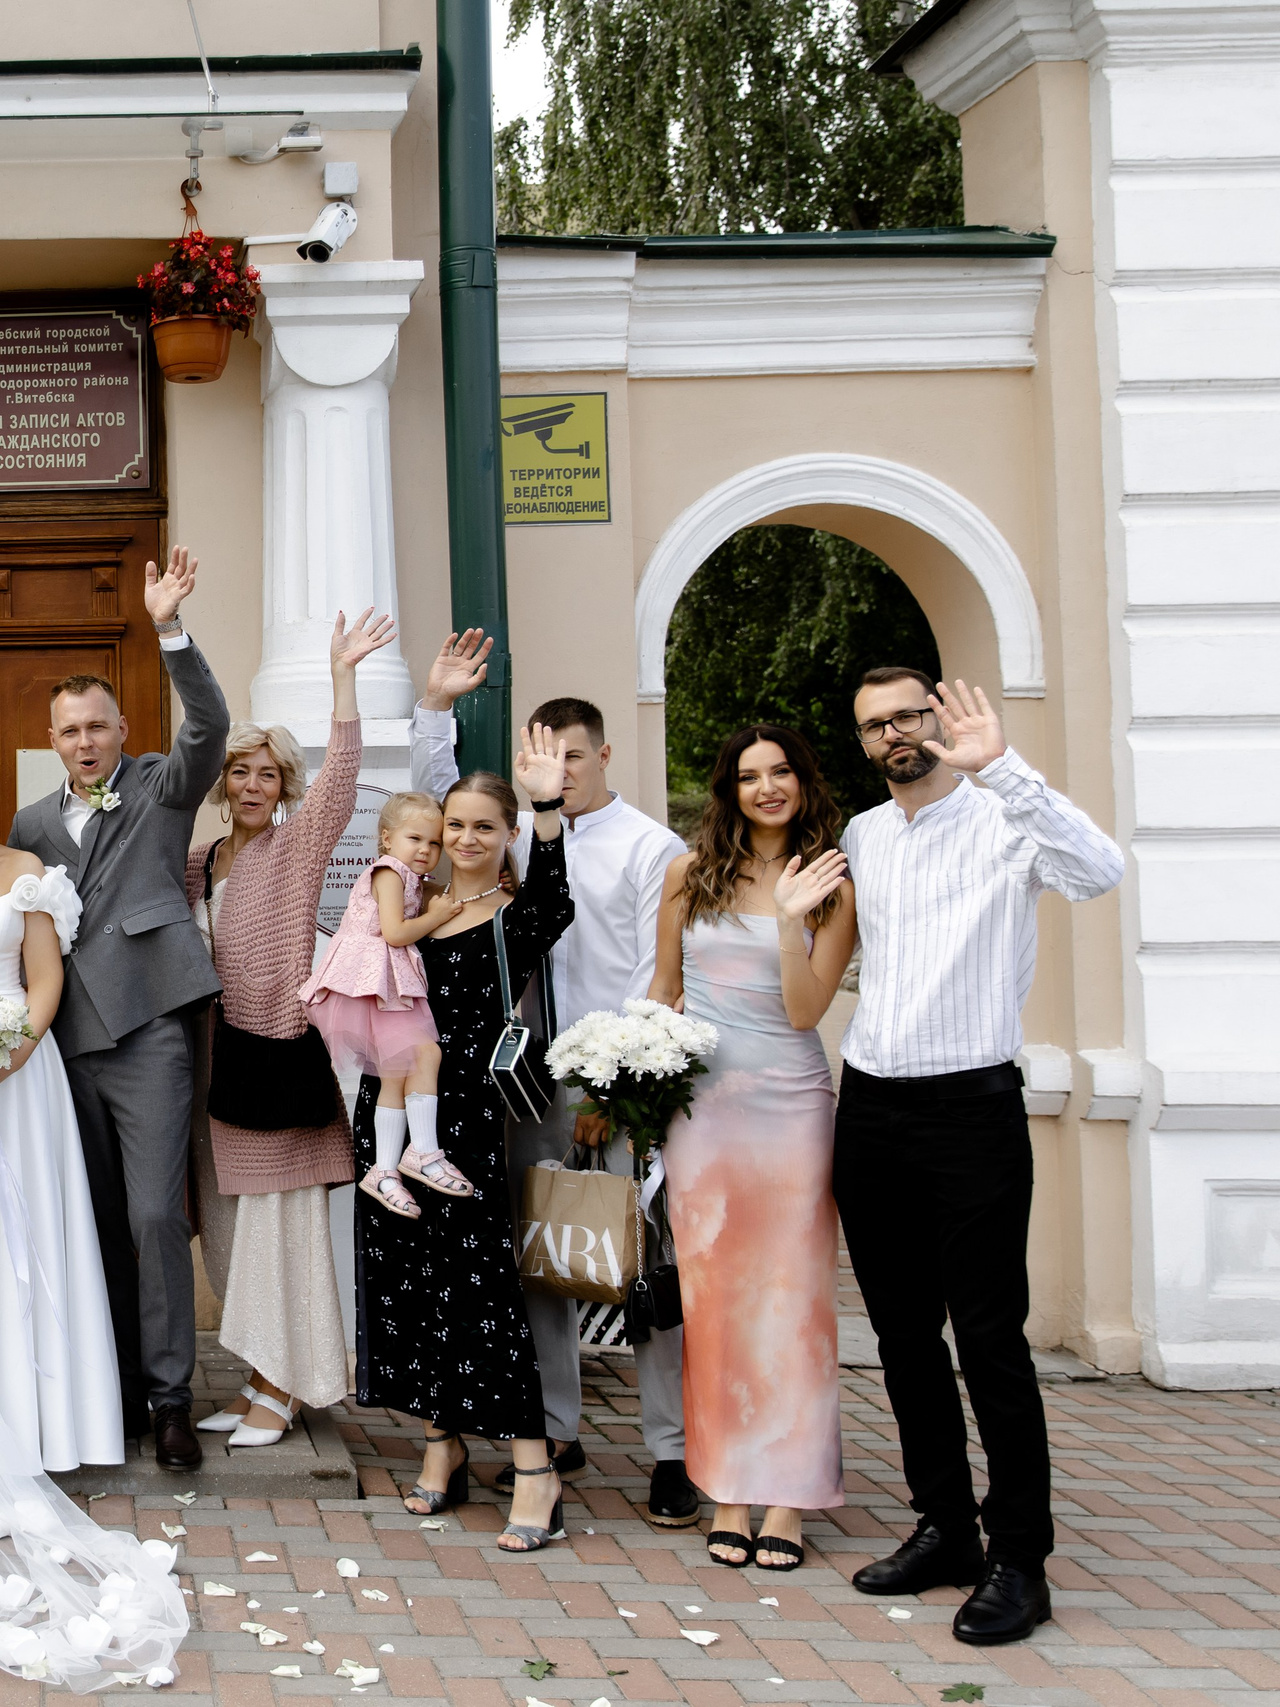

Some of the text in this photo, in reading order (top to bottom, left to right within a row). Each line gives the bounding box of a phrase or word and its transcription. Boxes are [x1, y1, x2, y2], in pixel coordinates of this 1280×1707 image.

[46, 325, 110, 340] городской
[74, 342, 124, 353] комитет
[83, 375, 129, 389] района
[6, 392, 74, 404] г.Витебска
[9, 413, 70, 429] ЗАПИСИ
[76, 412, 126, 427] АКТОВ
[510, 467, 600, 481] ТЕРРИТОРИИ
[514, 484, 573, 499] ВЕДЁТСЯ
[519, 1220, 622, 1287] ZARA
